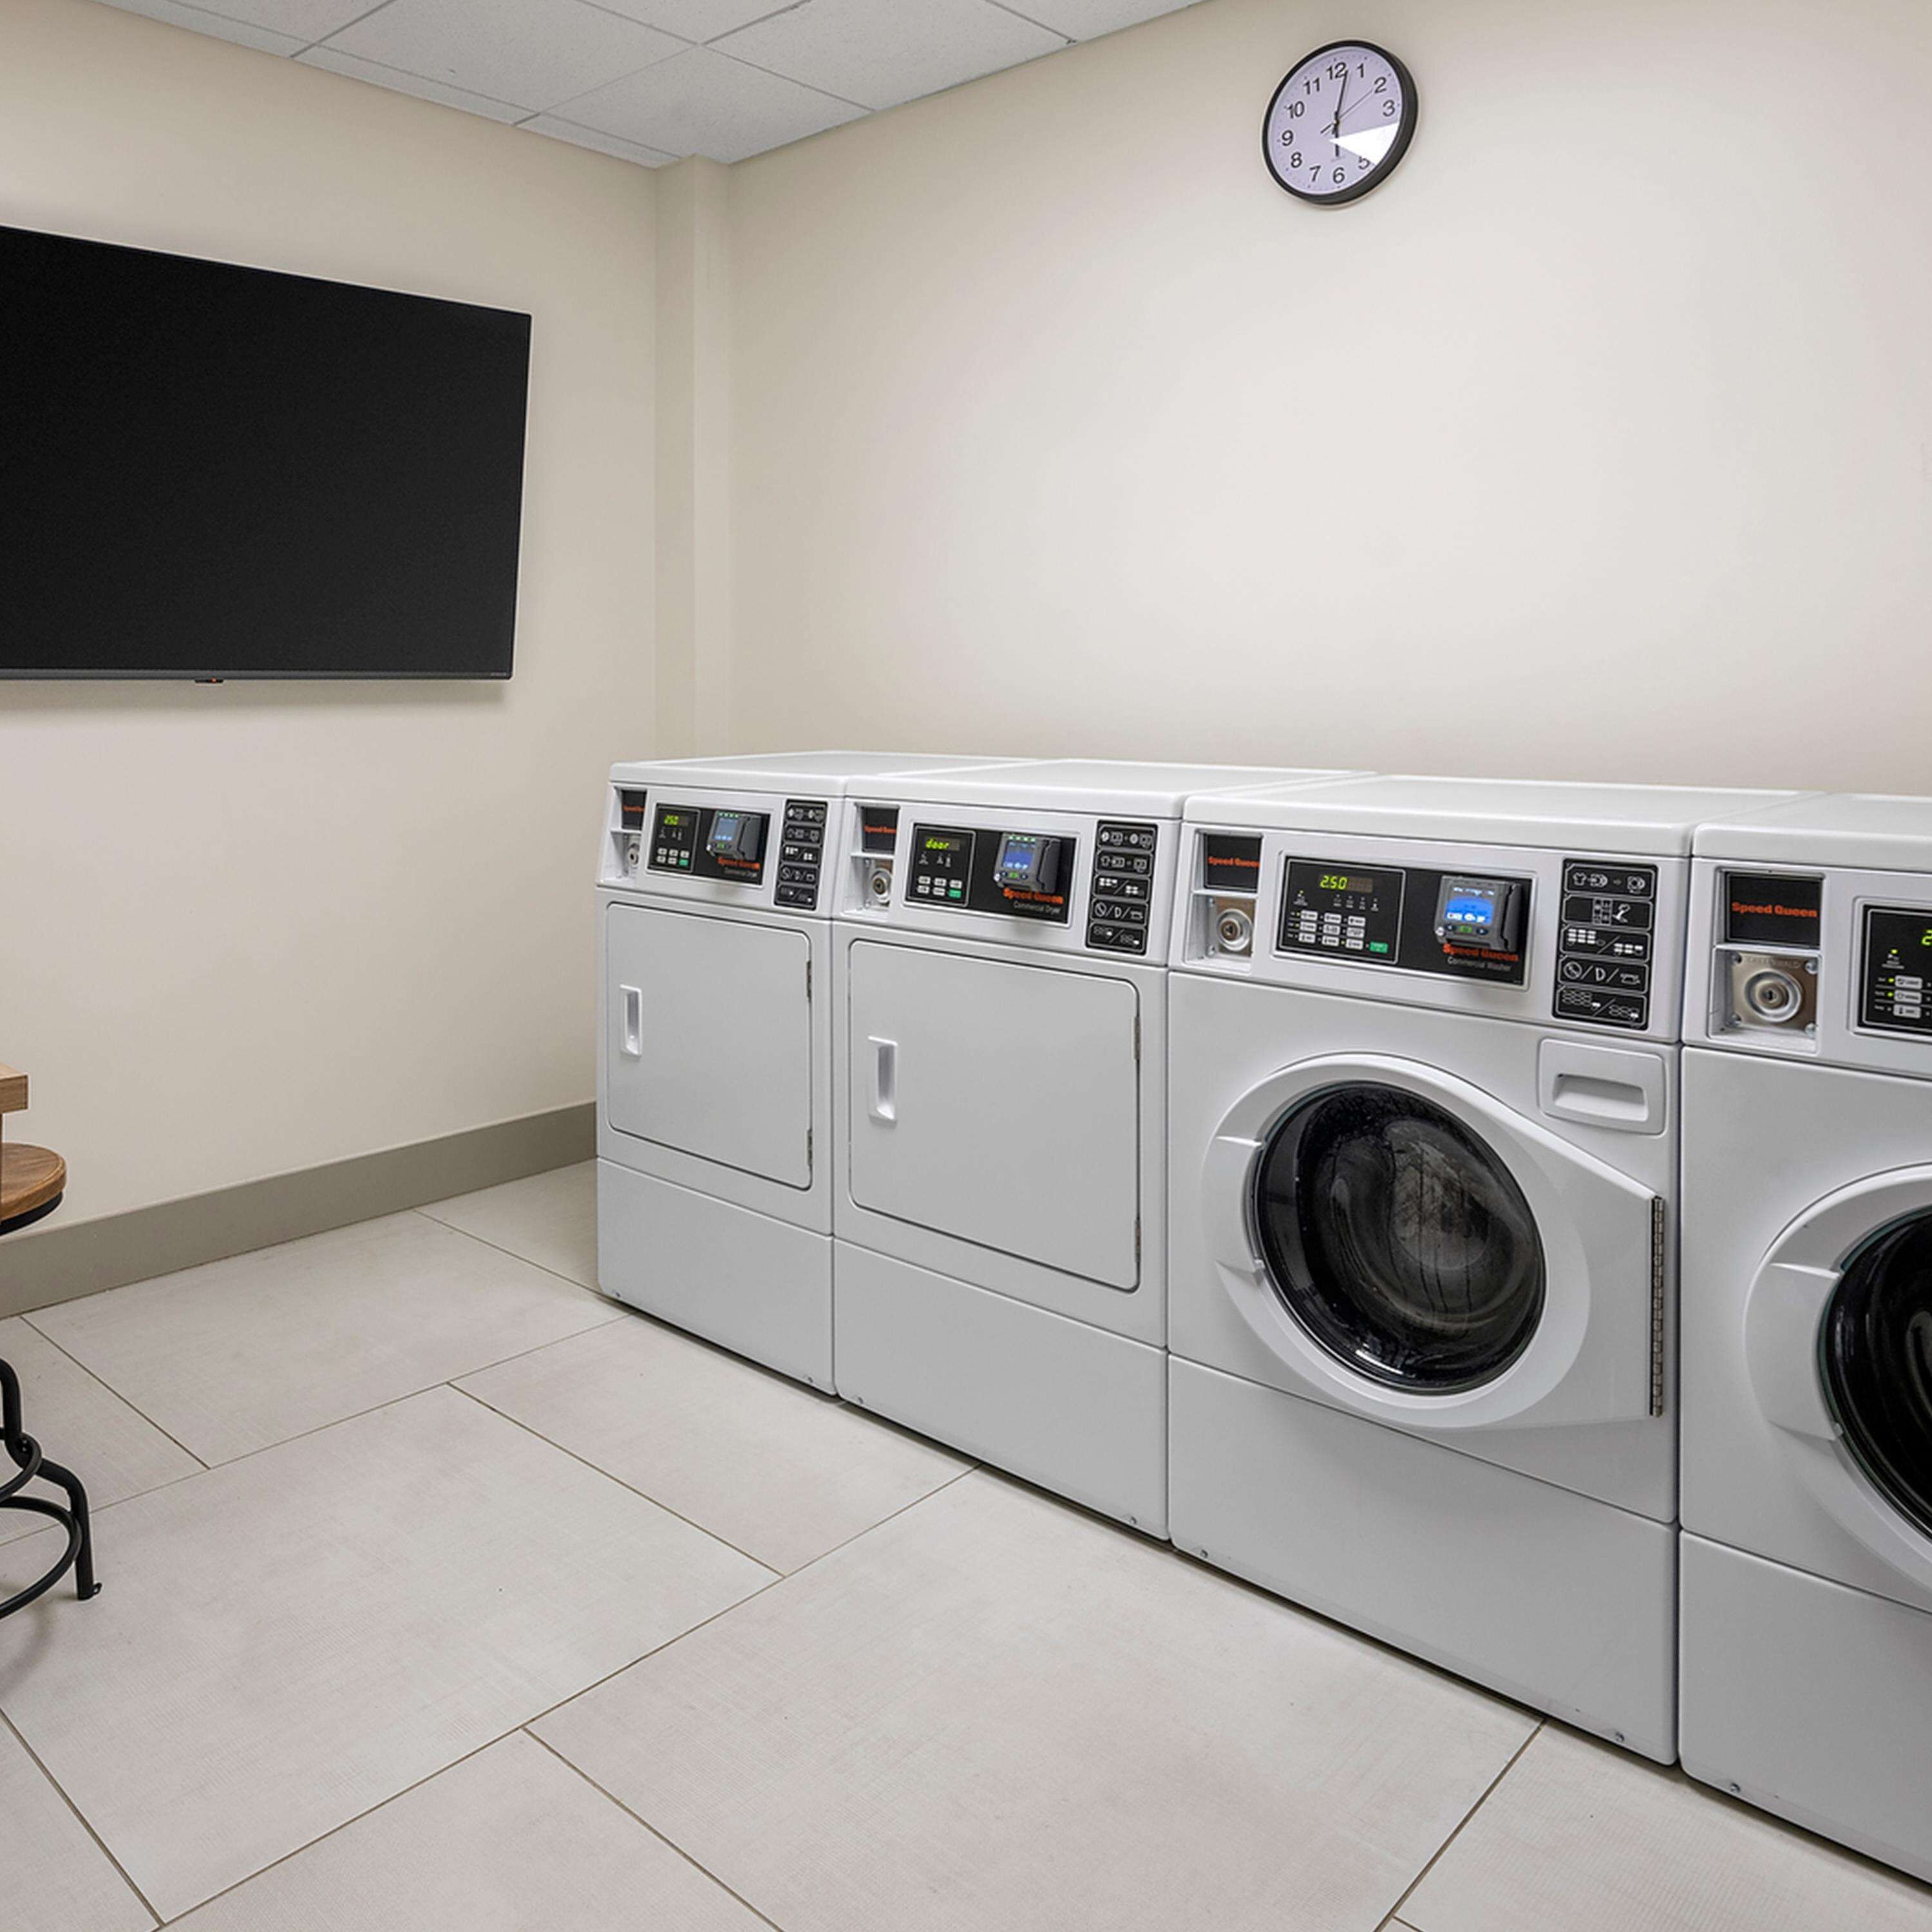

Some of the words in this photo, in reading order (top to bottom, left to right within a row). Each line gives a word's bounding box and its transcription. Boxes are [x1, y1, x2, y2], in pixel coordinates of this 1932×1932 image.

[1327, 62, 1347, 80] 12
[1357, 63, 1364, 78] 1
[1303, 77, 1320, 95] 11
[1374, 77, 1387, 93] 2
[1287, 100, 1305, 118] 10
[1383, 99, 1396, 117] 3
[1282, 130, 1294, 146] 9
[1291, 151, 1302, 168] 8
[1358, 156, 1370, 169] 5
[1309, 165, 1321, 182] 7
[1332, 166, 1345, 184] 6
[925, 838, 949, 849] door
[1208, 856, 1234, 866] Speed
[1732, 902, 1772, 913] Speed
[1774, 905, 1817, 917] Queen
[1443, 943, 1479, 956] Speed
